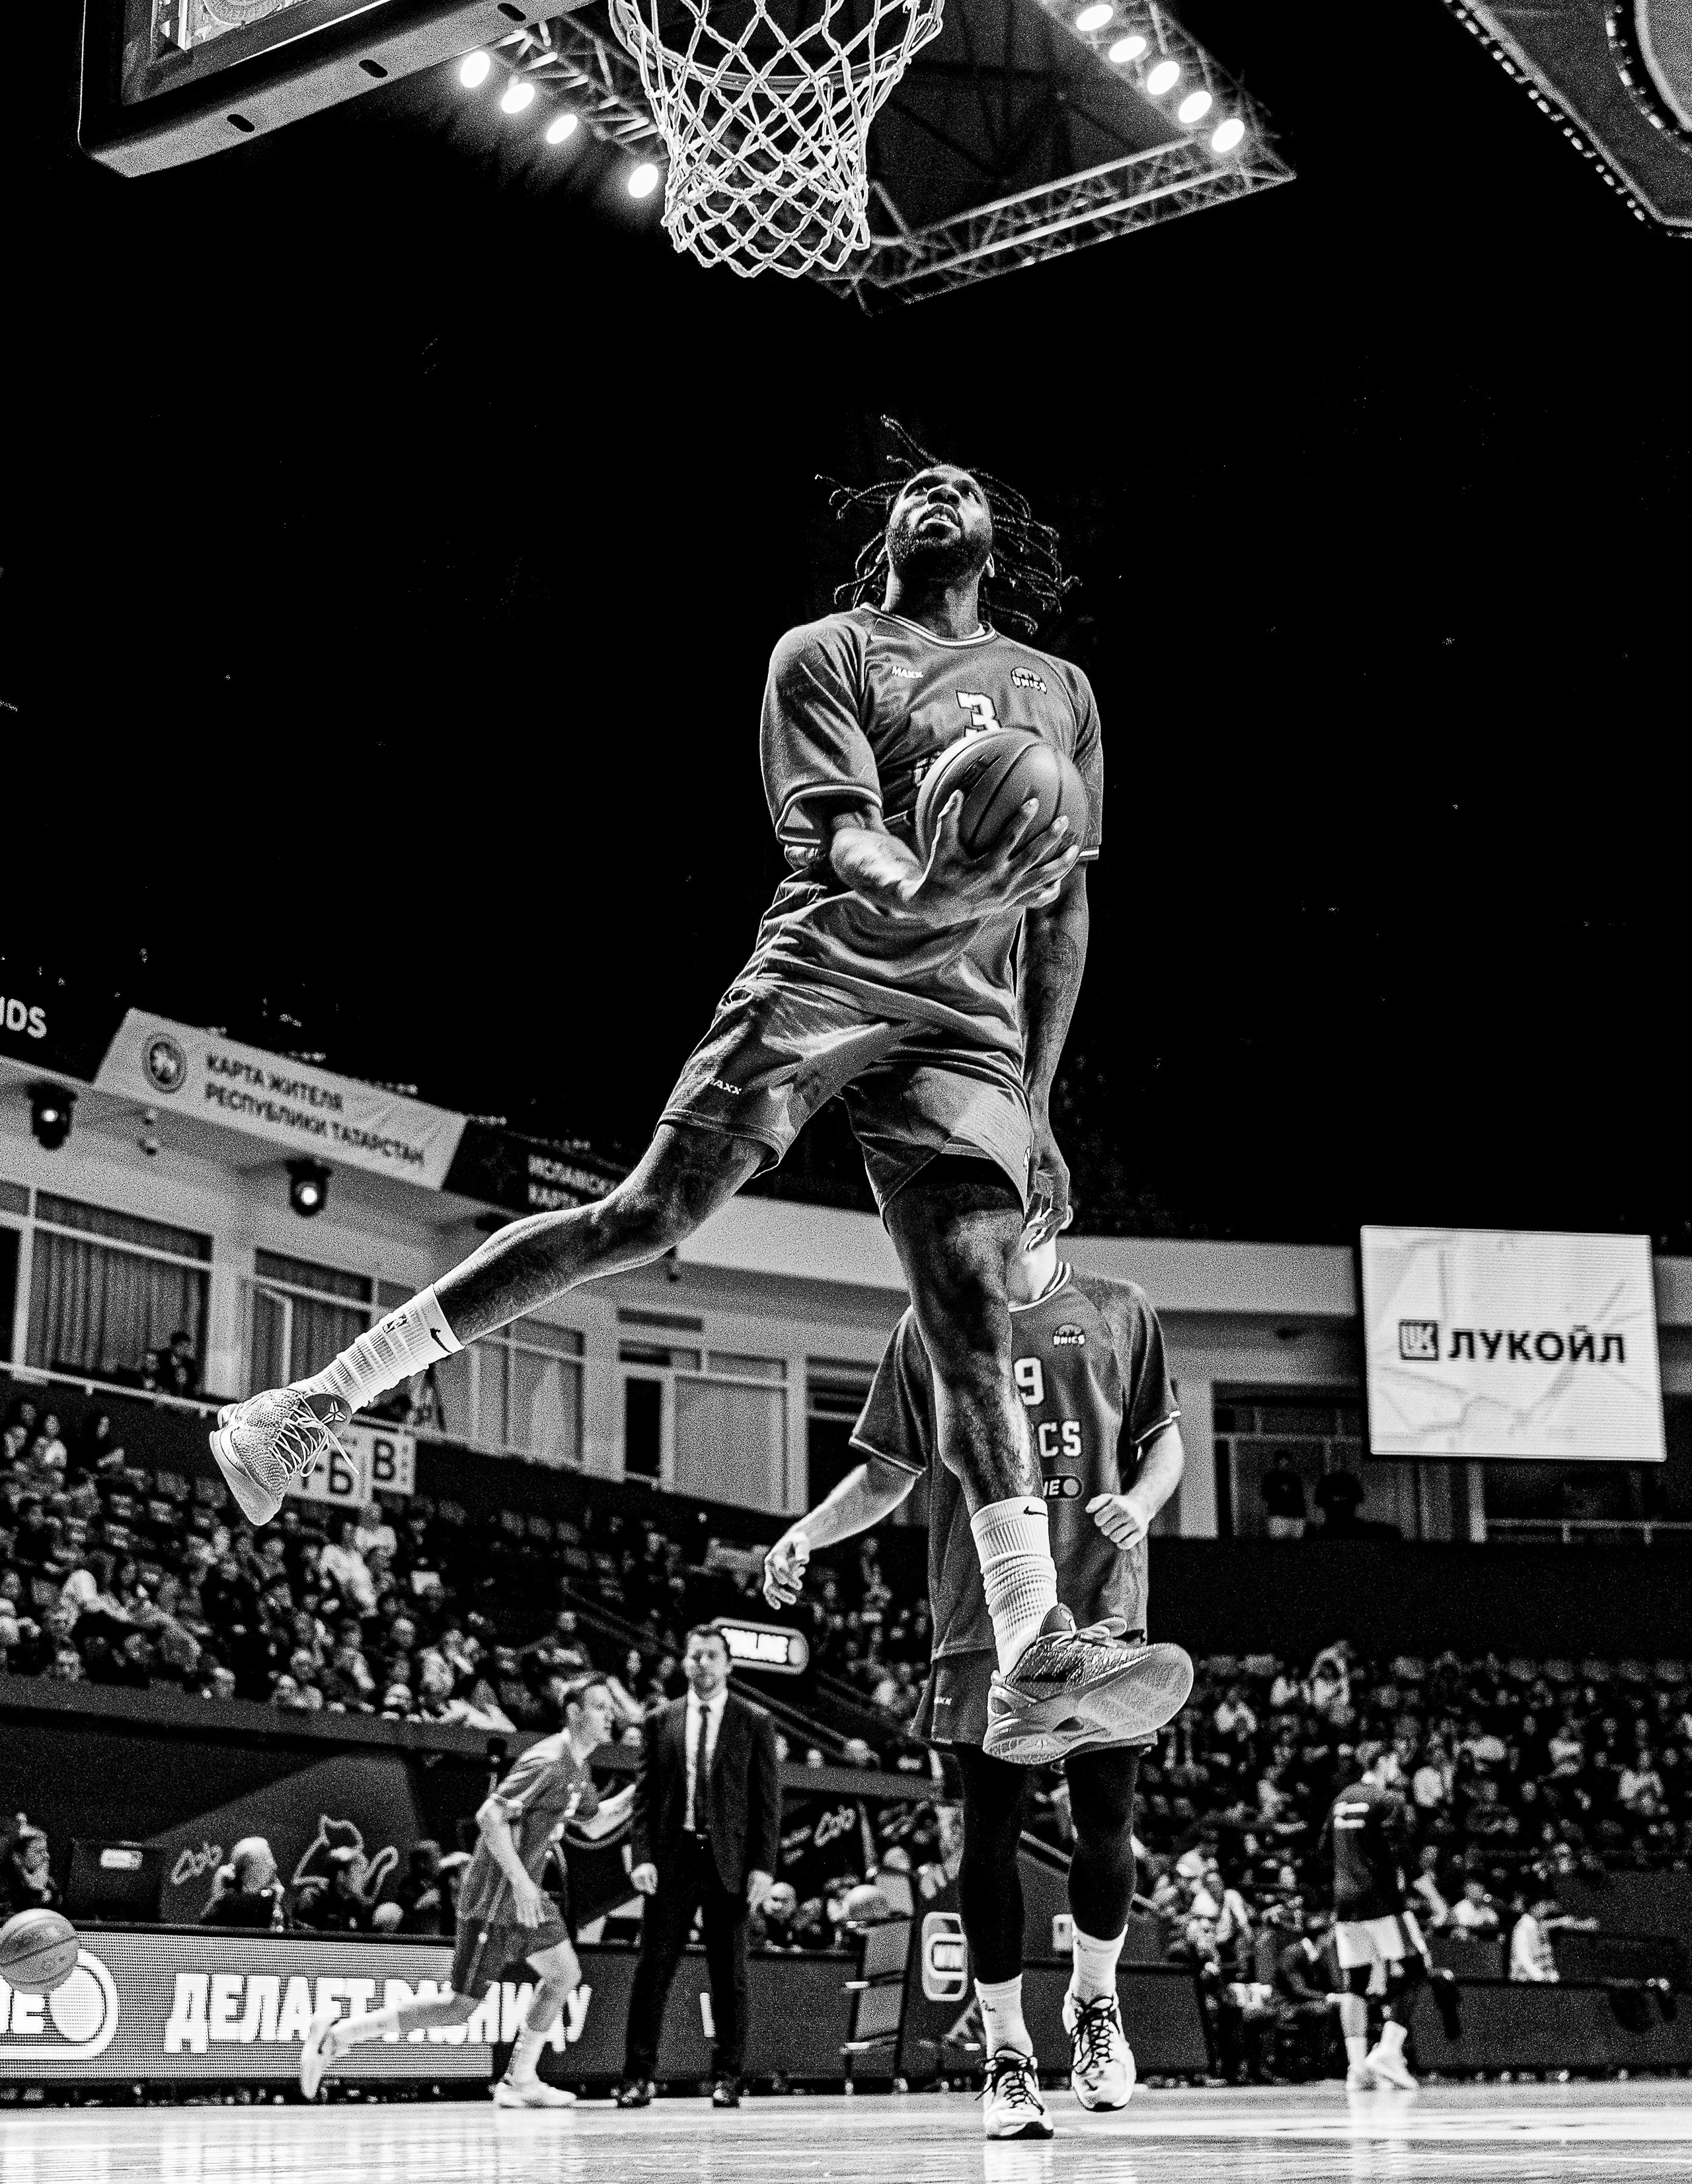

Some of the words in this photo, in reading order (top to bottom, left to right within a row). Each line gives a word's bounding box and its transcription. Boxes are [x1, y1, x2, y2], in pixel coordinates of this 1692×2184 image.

[892, 666, 924, 680] MAXX
[1012, 676, 1047, 694] UNICS
[956, 690, 1001, 738] 3
[206, 1054, 264, 1086] КАРТА
[269, 1075, 343, 1112] ЖИТЕЛЯ
[204, 1082, 327, 1137] РЕСПУБЛИКИ
[330, 1122, 424, 1166] ТАТАРСТАН
[1447, 1325, 1625, 1363] ЛУКОЙЛ
[1013, 1356, 1044, 1406] 9
[165, 1972, 377, 2054] ДЕЛАЕТ
